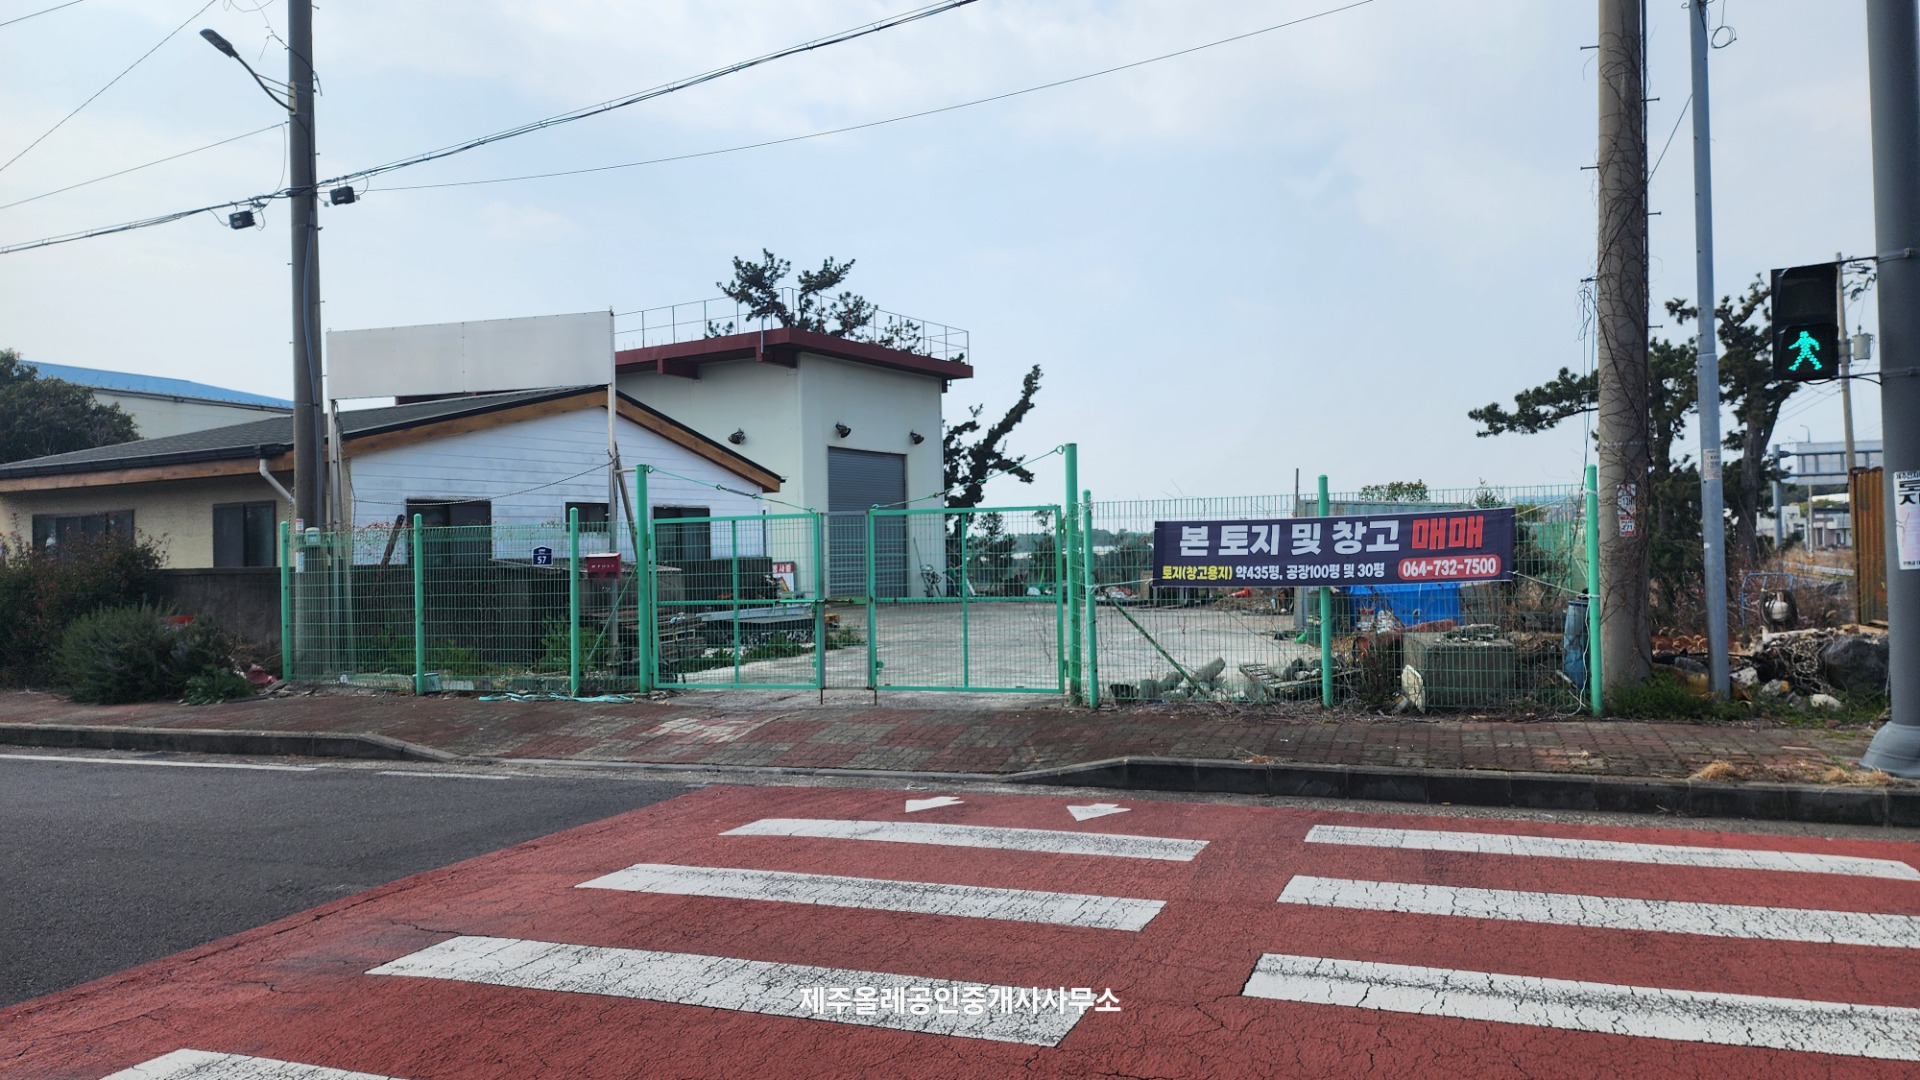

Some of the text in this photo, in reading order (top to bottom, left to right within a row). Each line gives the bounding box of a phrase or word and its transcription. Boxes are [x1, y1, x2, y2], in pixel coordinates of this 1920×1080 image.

[1180, 515, 1484, 556] 본 토지 및 창고 매매
[537, 556, 547, 564] 57
[1162, 557, 1497, 581] 토지(창고용지) 약435평, 공장100평 및 30평 064-732-7500
